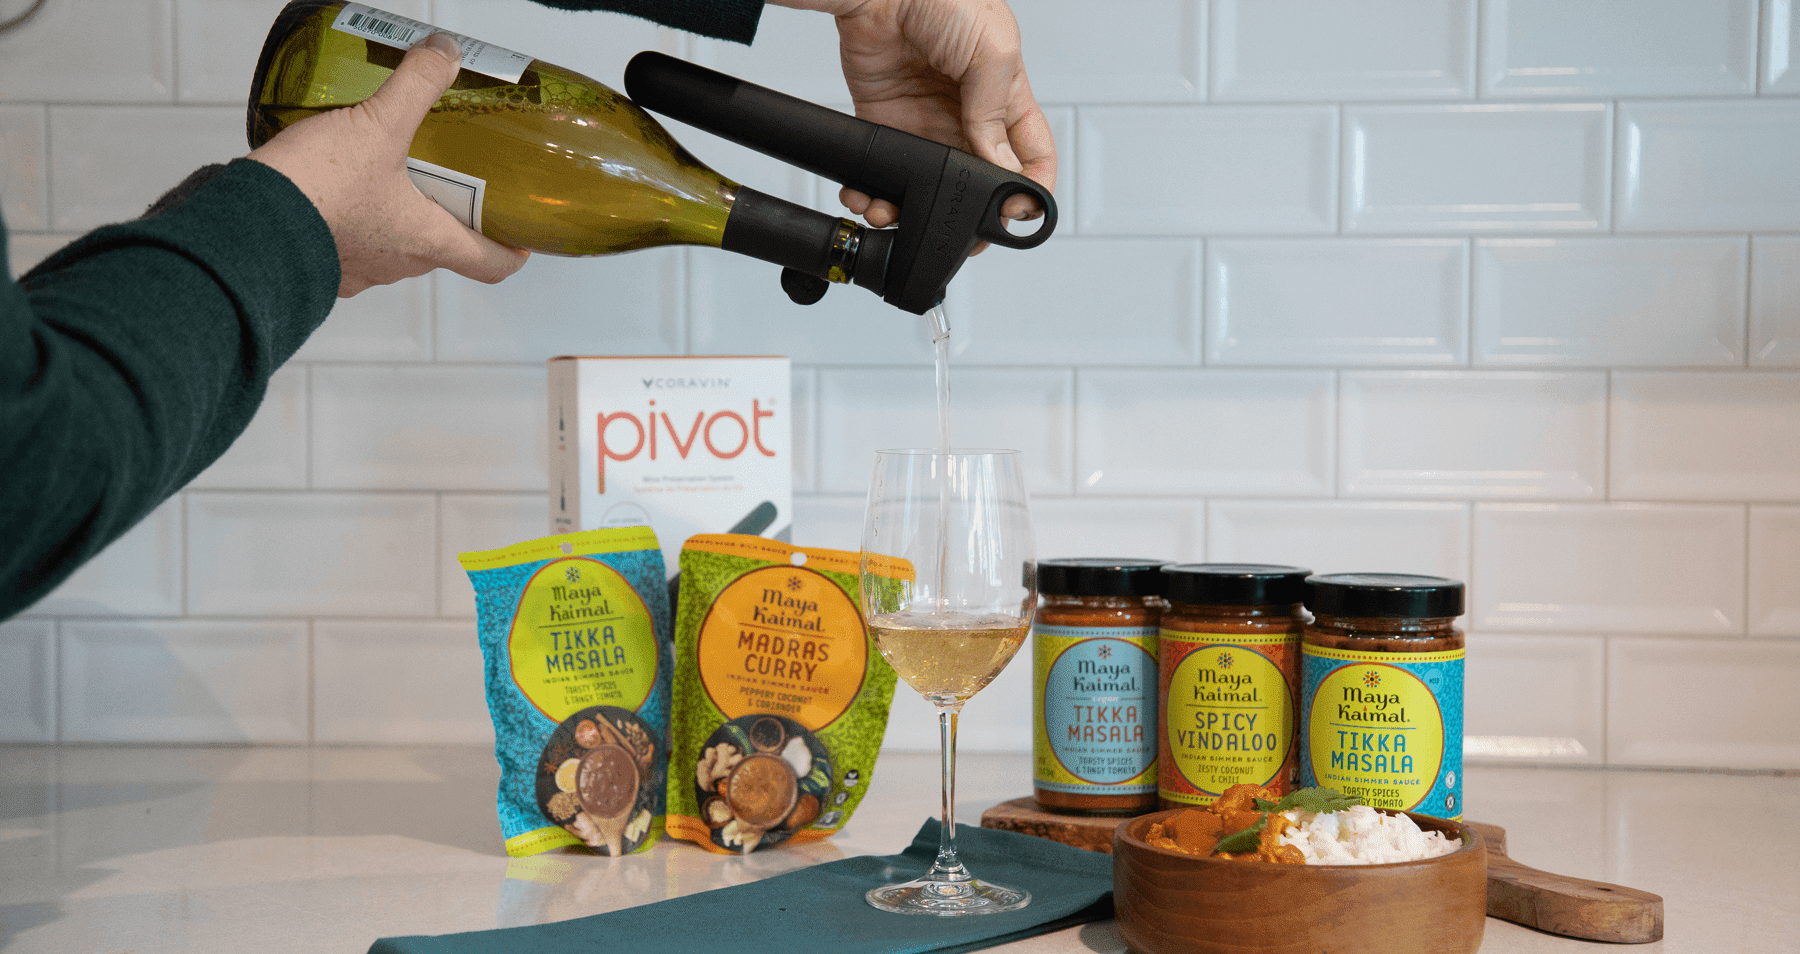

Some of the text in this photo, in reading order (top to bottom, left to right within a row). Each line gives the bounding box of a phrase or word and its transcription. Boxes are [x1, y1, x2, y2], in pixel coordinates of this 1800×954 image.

[936, 168, 971, 254] CORAVIN
[655, 377, 731, 389] CORAVIN
[597, 398, 776, 494] pivot
[551, 584, 602, 606] Maya
[763, 588, 818, 616] Maya
[550, 625, 615, 651] TIKKA
[738, 630, 830, 662] MADRAS
[545, 645, 626, 673] MASALA
[745, 653, 818, 683] CURRY
[543, 667, 634, 684] INDIAN SIMMER SAUCE
[1078, 660, 1130, 680] Maya
[761, 679, 796, 689] SIMMER
[800, 685, 829, 695] SAUCE
[1198, 668, 1252, 691] Maya
[740, 686, 813, 704] PEPPERY COCONUT
[1343, 686, 1400, 710] Maya
[756, 699, 801, 713] CORIANDER
[1074, 705, 1137, 723] TIKKA
[1195, 712, 1258, 730] SPICY
[1067, 725, 1144, 743] MASALA
[1177, 729, 1277, 751] VINDALOO
[1337, 730, 1406, 753] TIKKA
[1079, 756, 1133, 766] TOASTY SPICES
[1181, 753, 1207, 761] INDIAN
[1210, 755, 1242, 763] SIMMER
[1331, 750, 1413, 773] MASALA
[1082, 766, 1106, 774] TANGY
[1108, 766, 1136, 775] TOMATO
[1198, 764, 1254, 775] ZESTY COCONUT
[1211, 774, 1240, 784] & CHILI
[1325, 773, 1351, 782] INDIAN
[1354, 777, 1389, 785] SIMMER
[1342, 785, 1400, 797] TOASTY SPICES
[1373, 798, 1403, 808] TOMATO
